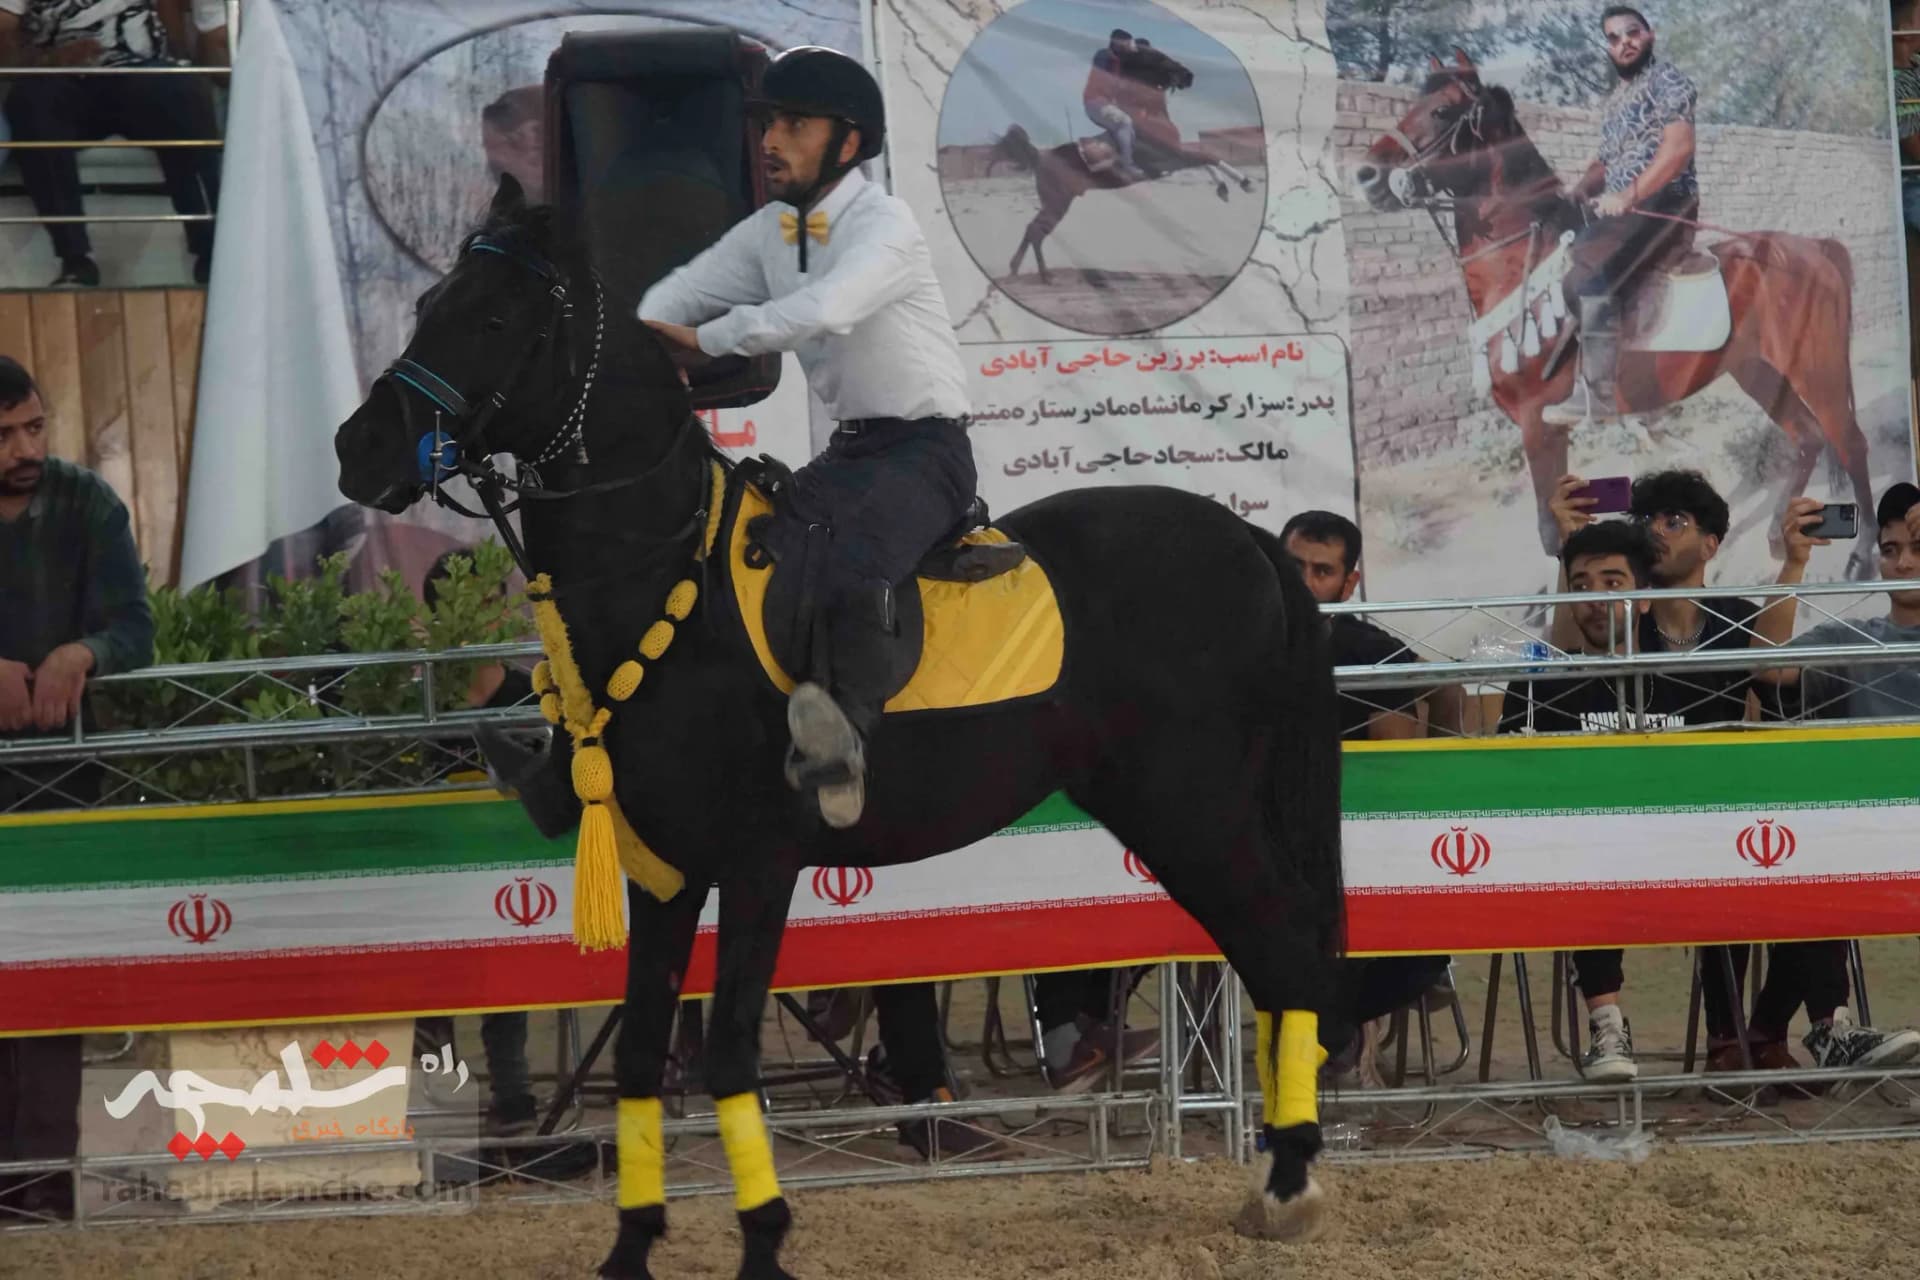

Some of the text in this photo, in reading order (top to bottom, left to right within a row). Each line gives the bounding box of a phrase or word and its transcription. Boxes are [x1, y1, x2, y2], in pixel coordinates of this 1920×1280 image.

[980, 346, 1052, 377] آبادی
[1056, 347, 1132, 374] حاجی
[1003, 446, 1074, 476] آبادی
[1580, 711, 1685, 732] LOUIS VITTON
